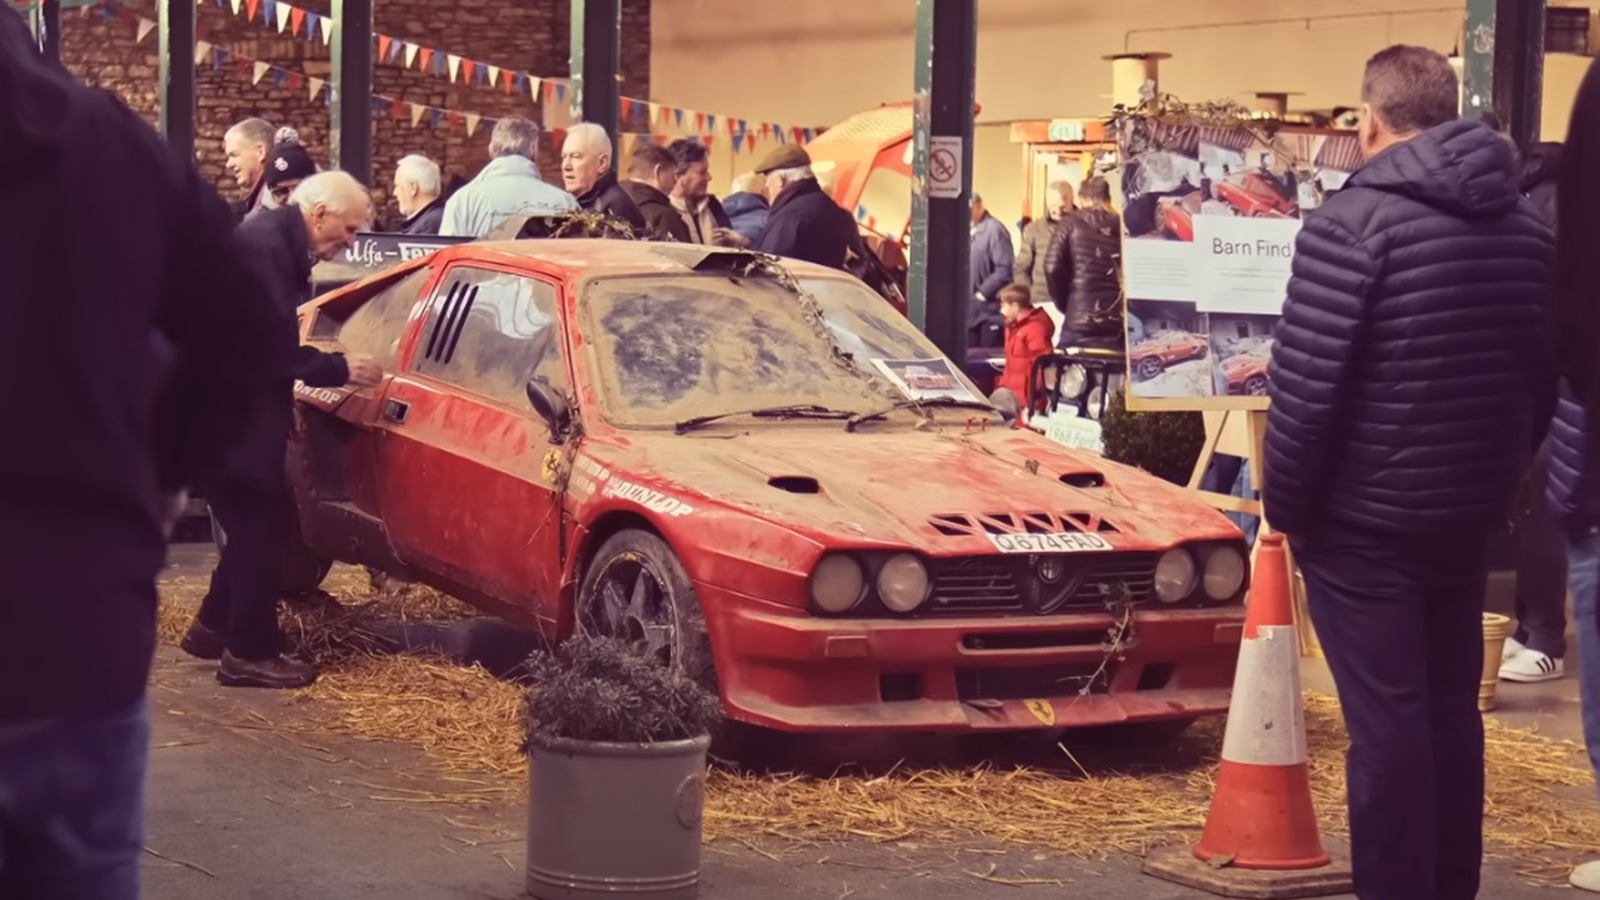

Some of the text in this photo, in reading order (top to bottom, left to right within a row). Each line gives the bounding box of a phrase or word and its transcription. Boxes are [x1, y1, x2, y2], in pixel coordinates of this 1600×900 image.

[1212, 237, 1292, 258] Barn Find
[293, 379, 341, 404] UNLOP
[616, 480, 694, 517] DUNLOP
